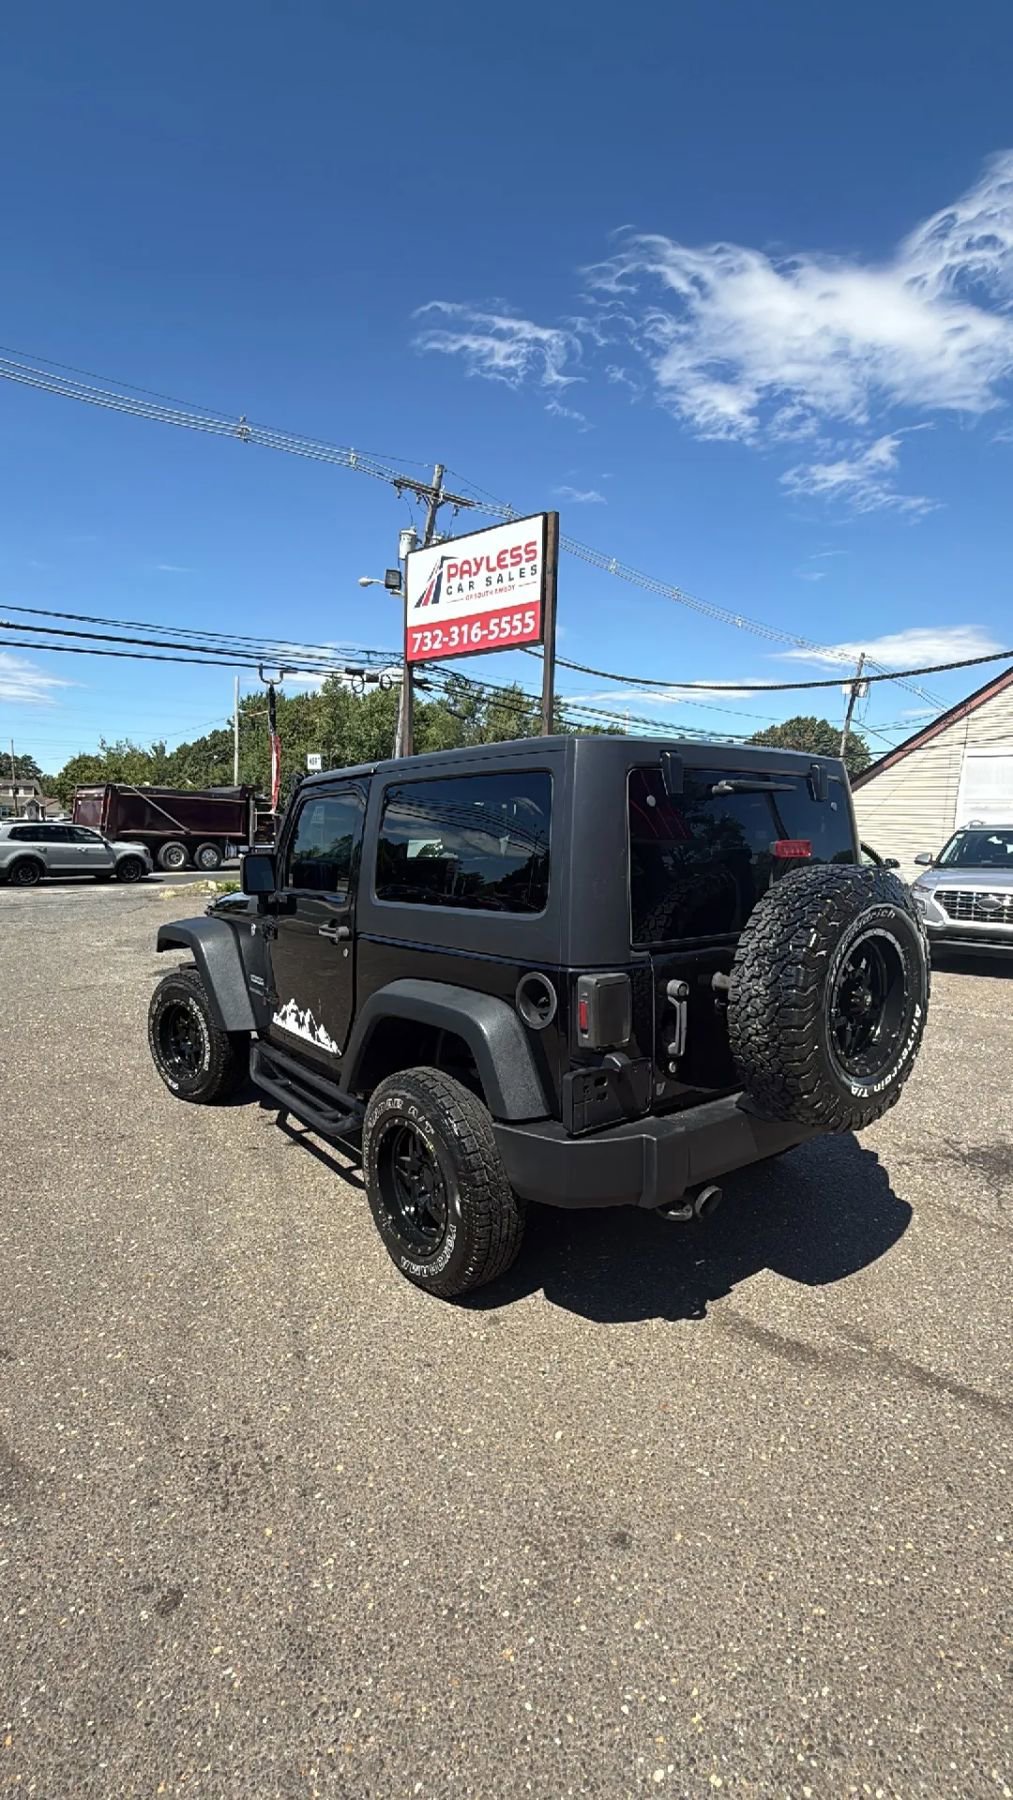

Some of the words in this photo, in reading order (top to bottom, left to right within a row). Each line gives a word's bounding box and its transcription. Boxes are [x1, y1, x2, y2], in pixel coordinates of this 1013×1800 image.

[446, 540, 538, 583] PAYLESS
[446, 580, 475, 596] CAR
[485, 564, 538, 588] SALES
[412, 611, 536, 653] 732-316-5555
